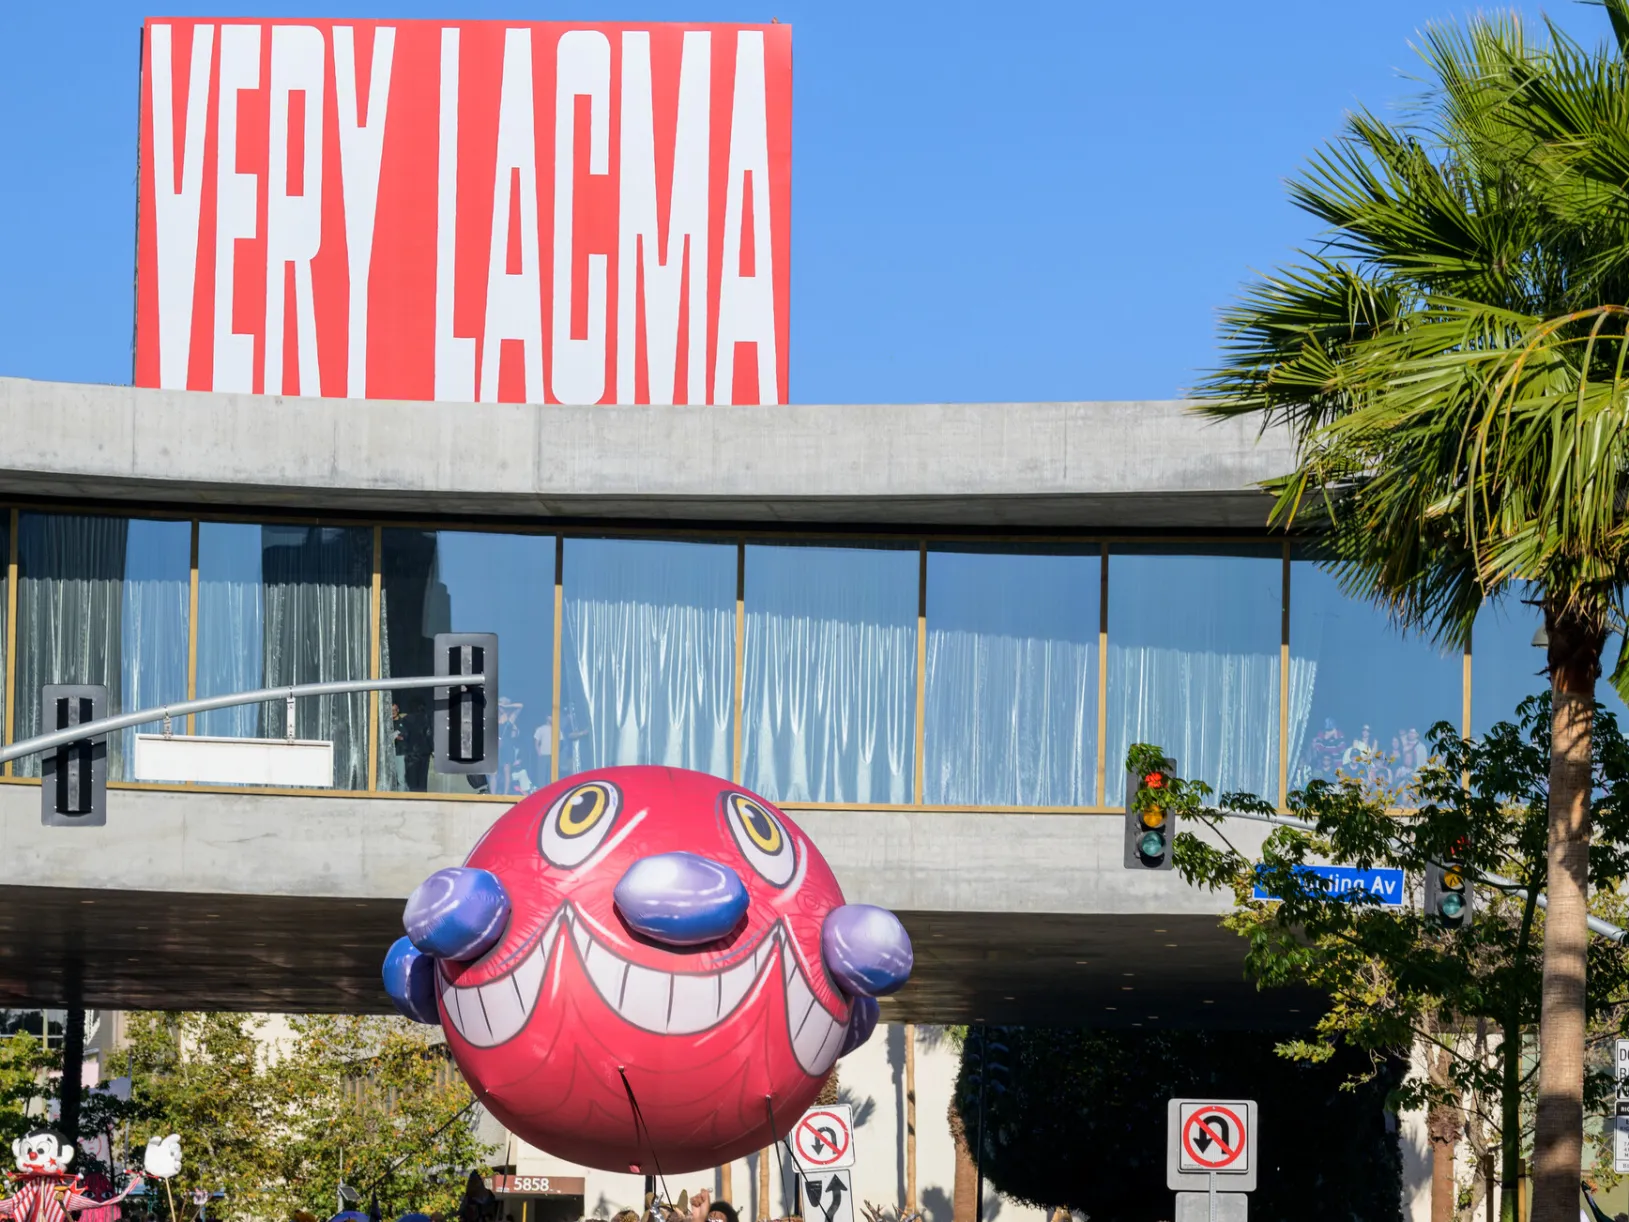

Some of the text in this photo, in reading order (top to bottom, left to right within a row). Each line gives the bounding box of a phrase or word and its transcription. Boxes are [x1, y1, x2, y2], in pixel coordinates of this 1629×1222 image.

[151, 24, 778, 405] VERY LACMA
[1370, 875, 1397, 895] Av
[514, 1177, 549, 1191] 5858
